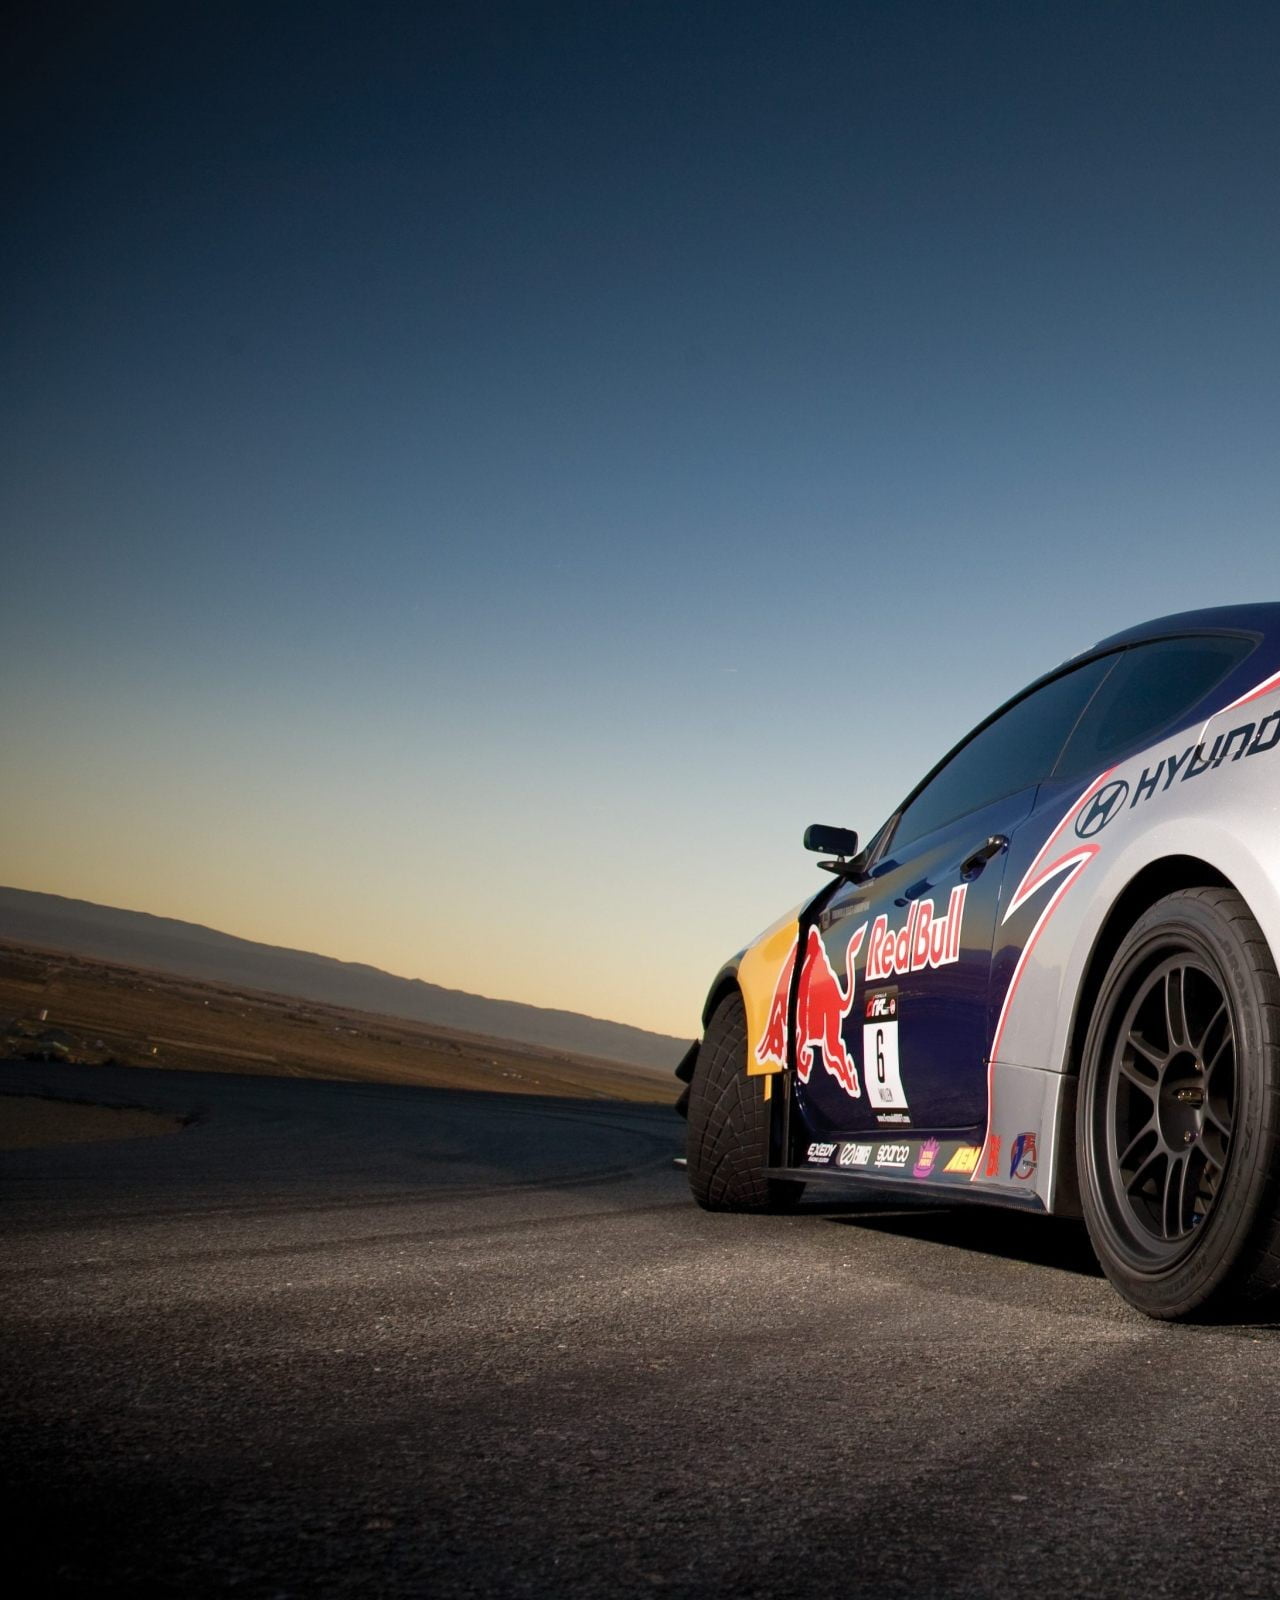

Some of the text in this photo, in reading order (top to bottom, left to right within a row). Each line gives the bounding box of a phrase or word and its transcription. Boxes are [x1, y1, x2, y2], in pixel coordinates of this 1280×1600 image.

[876, 1028, 885, 1083] 6
[807, 1142, 837, 1157] EXEDY
[876, 1144, 910, 1167] sparco
